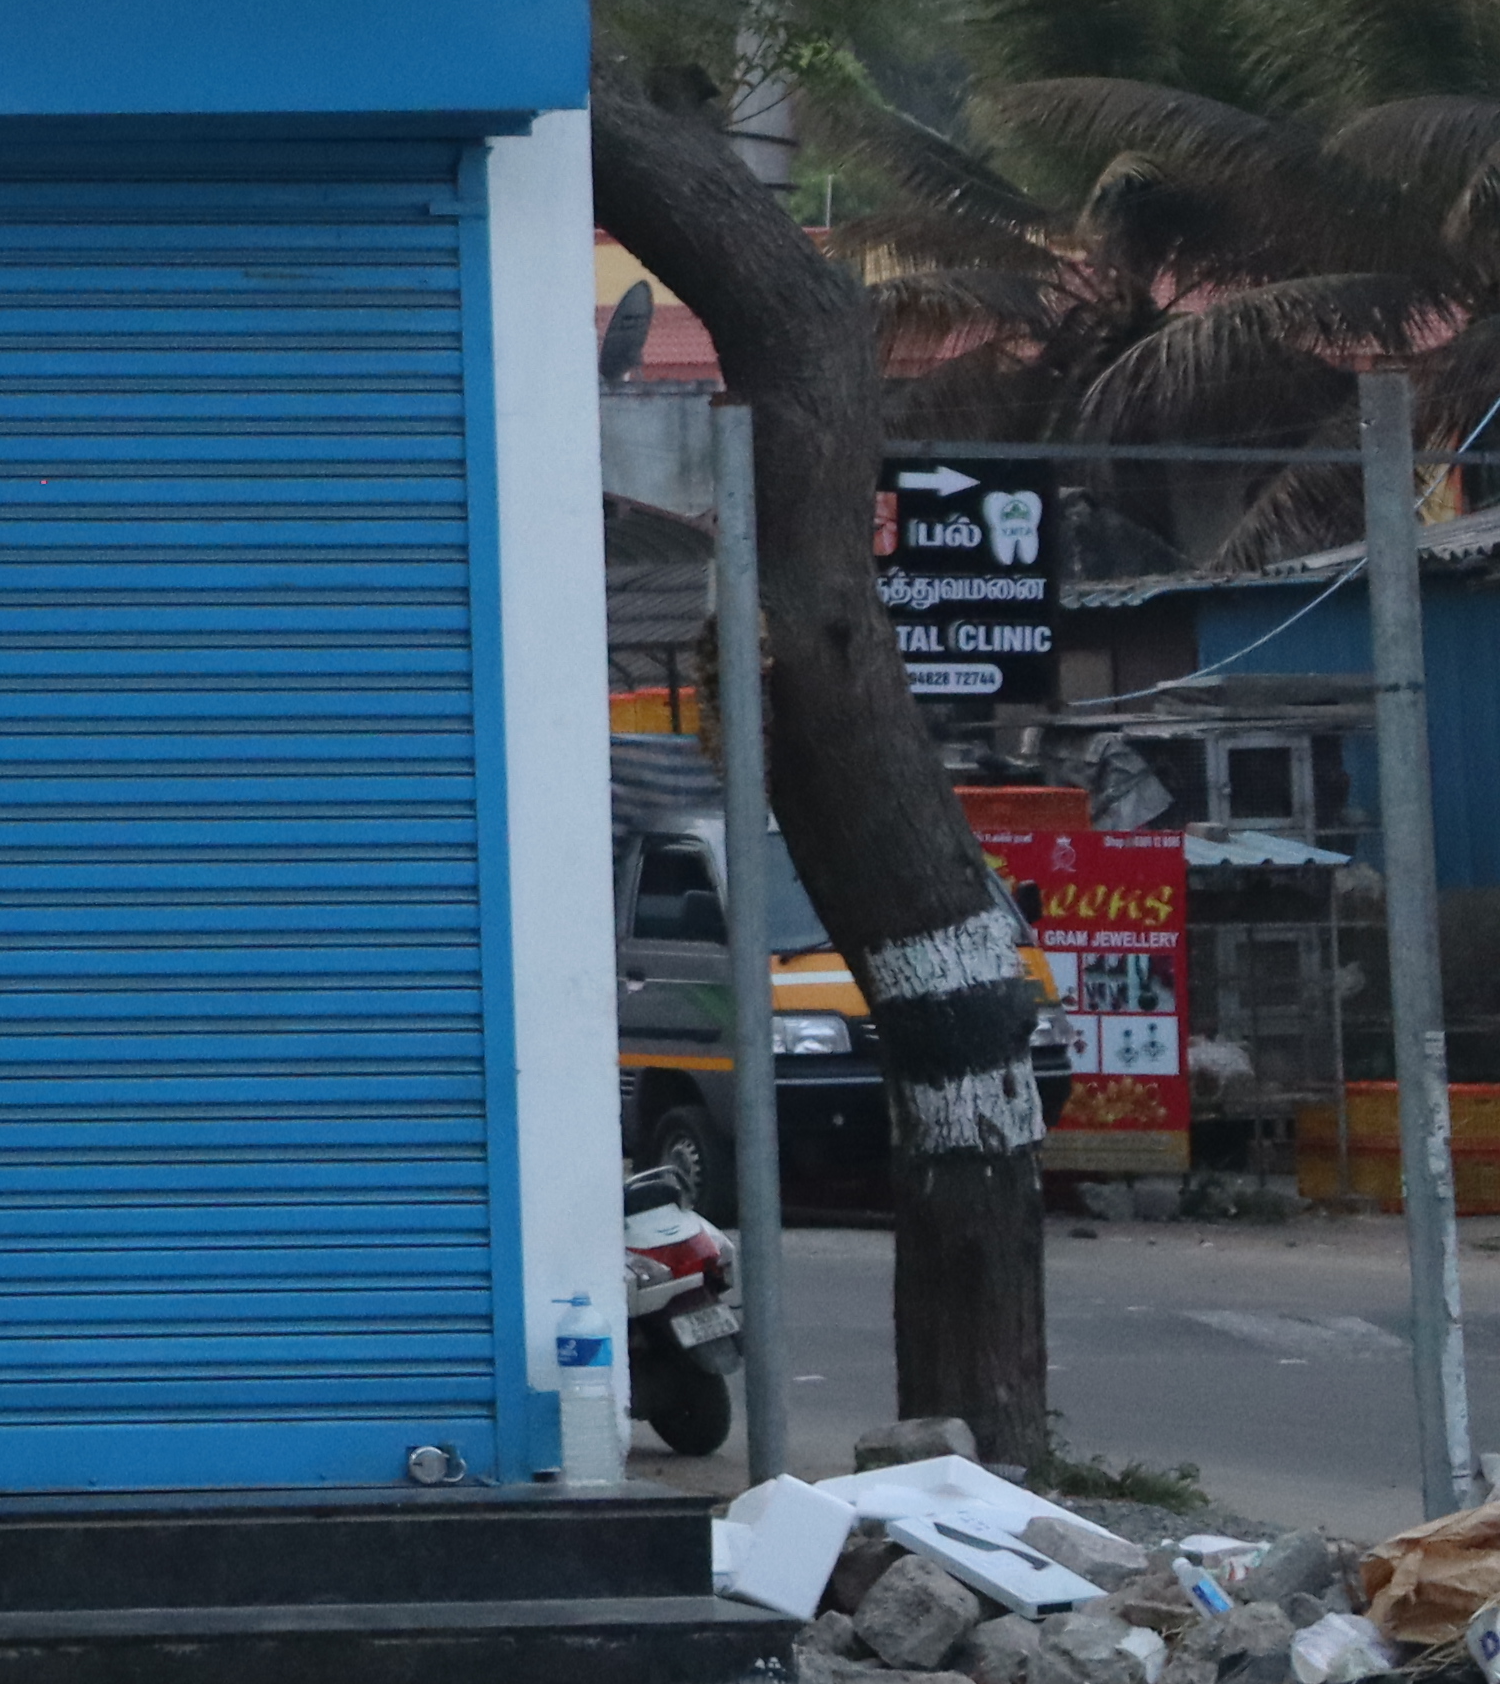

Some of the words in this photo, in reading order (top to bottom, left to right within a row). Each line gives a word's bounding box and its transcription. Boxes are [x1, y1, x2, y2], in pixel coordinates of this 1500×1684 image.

[896, 624, 945, 652] TAL
[956, 623, 1052, 653] CLINIC
[1044, 929, 1089, 946] GRAM
[1092, 931, 1180, 947] JEWELLERY
